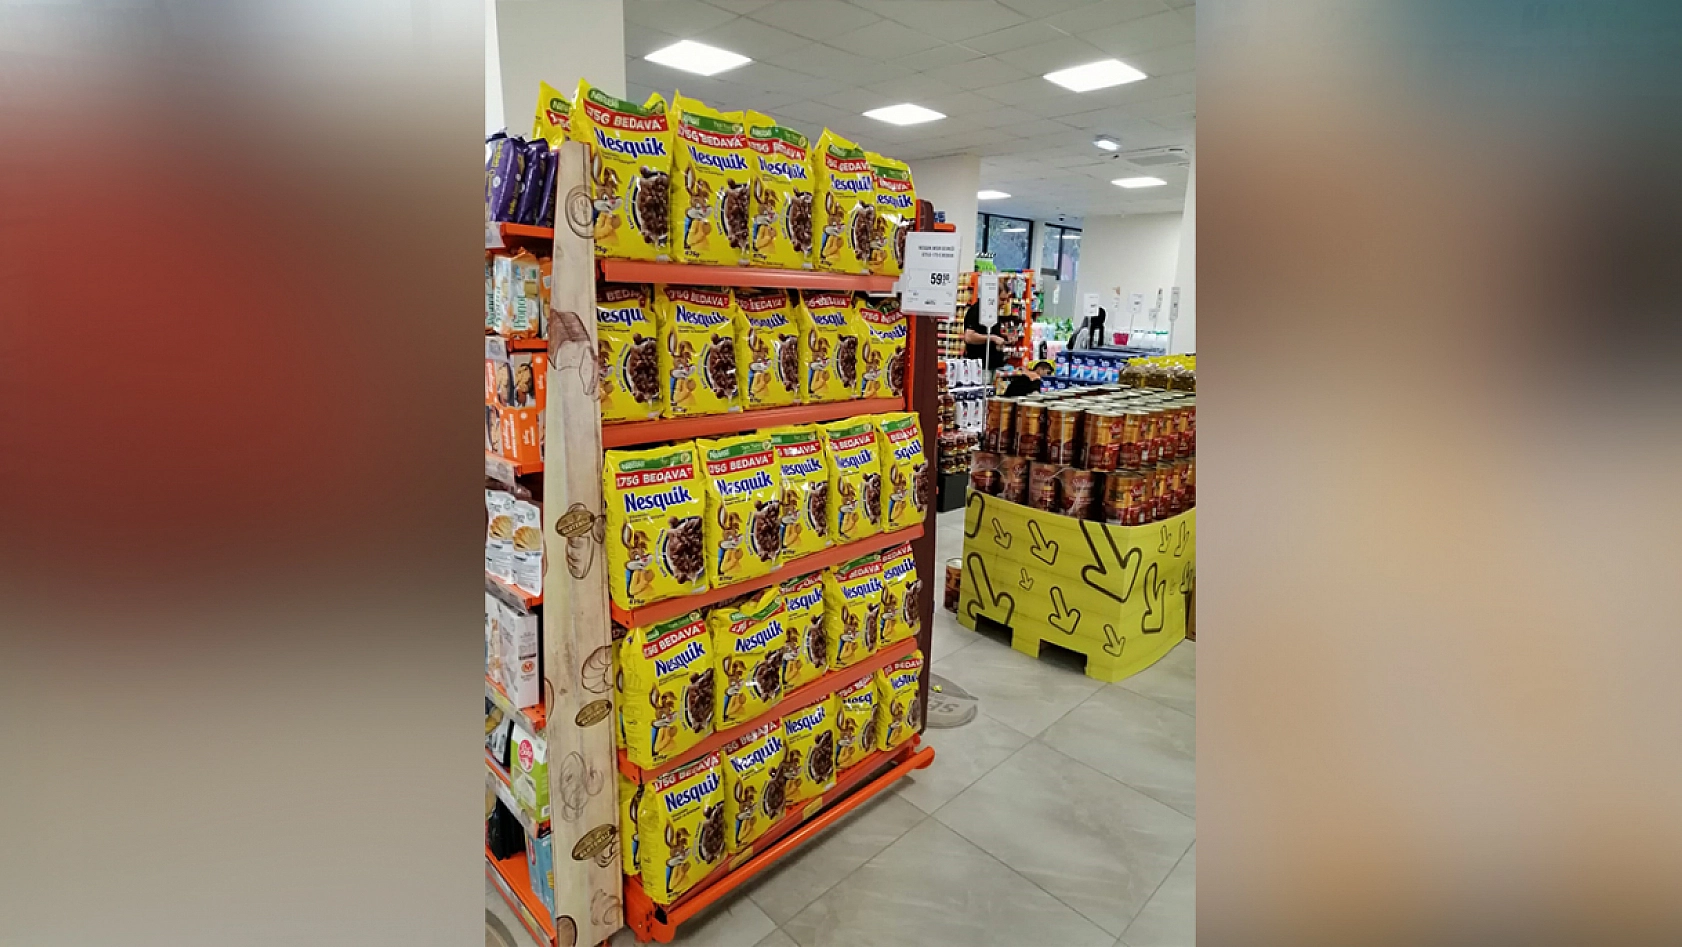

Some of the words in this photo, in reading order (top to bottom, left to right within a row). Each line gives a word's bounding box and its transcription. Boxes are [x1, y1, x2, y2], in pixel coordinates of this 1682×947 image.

[594, 126, 667, 160] Nesquik
[687, 144, 749, 172] Nesquik
[757, 155, 808, 181] Nesquik
[876, 194, 914, 209] esquik
[930, 272, 942, 285] 59
[643, 467, 689, 484] BEDAVA
[780, 457, 823, 477] esquik
[624, 485, 692, 513] Nesquik
[884, 557, 916, 580] esquik
[659, 625, 702, 650] BEDAVA
[735, 619, 784, 653] Nesquik
[655, 641, 706, 678] Nesquik
[729, 735, 783, 773] Nesquik
